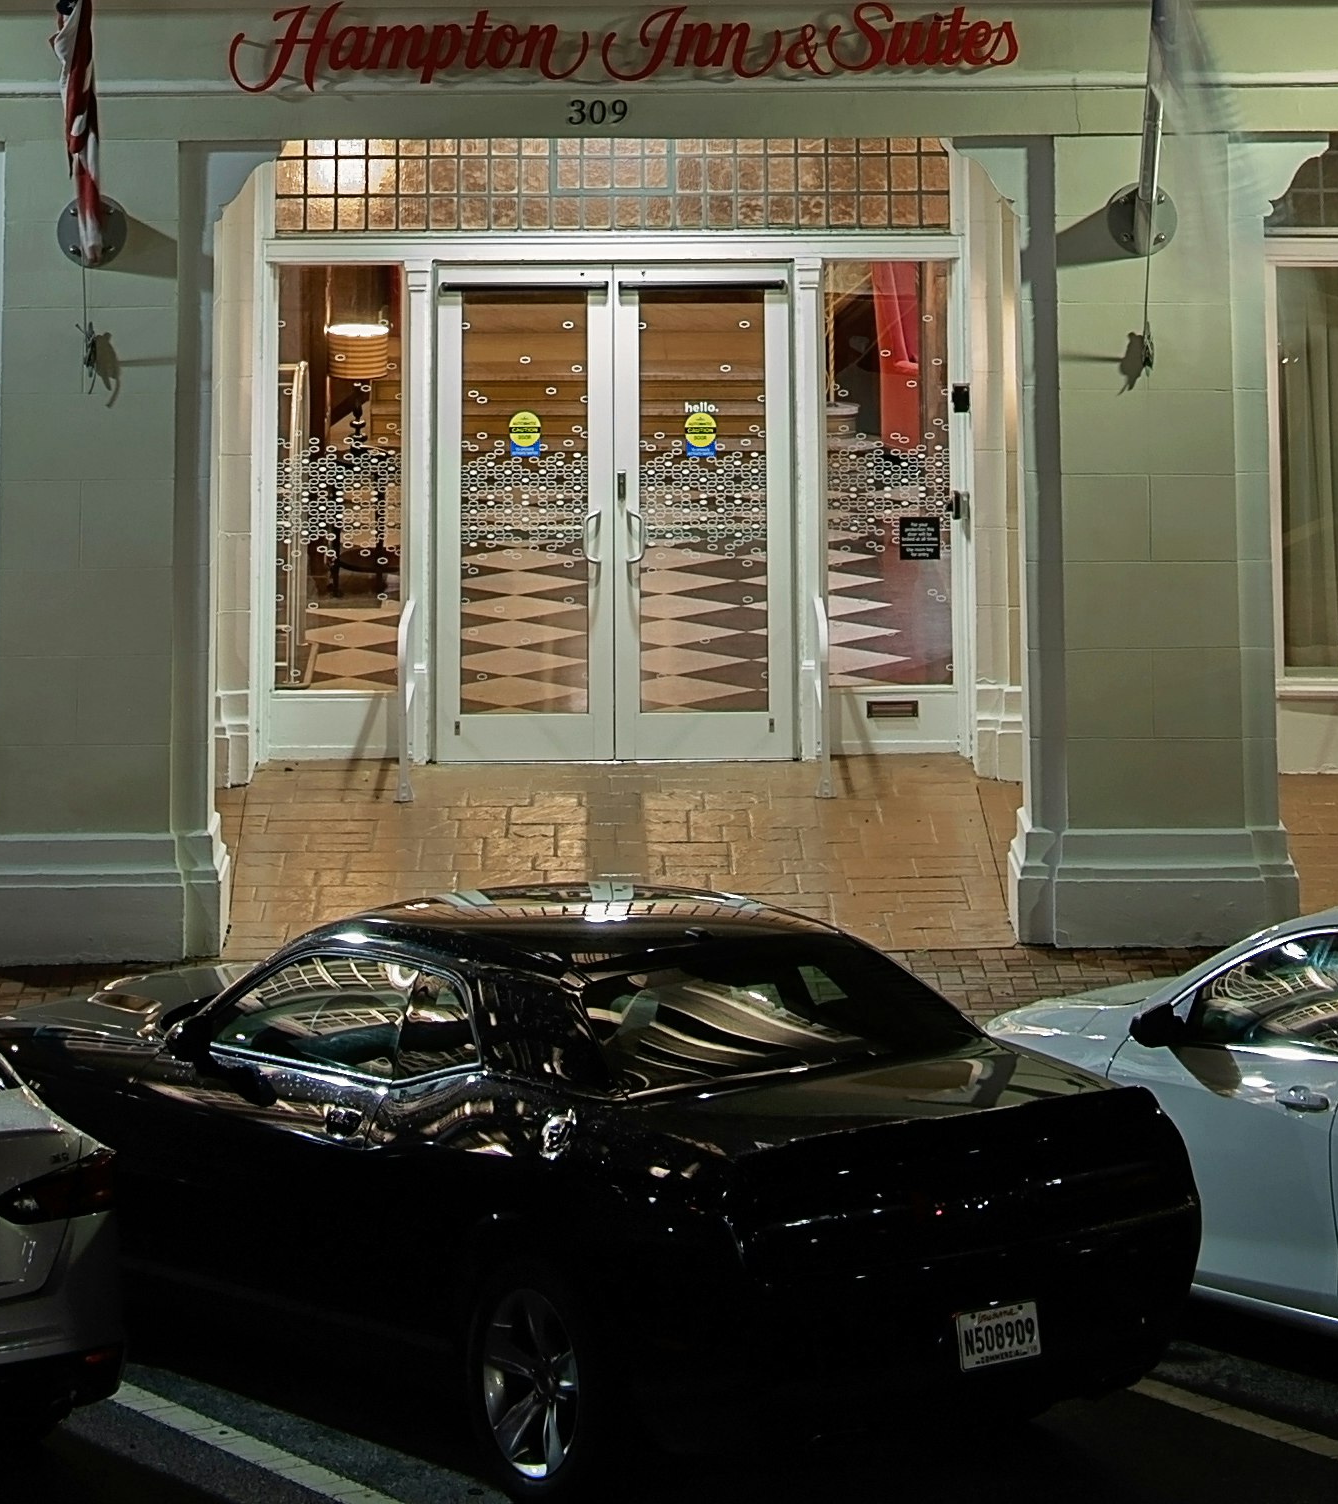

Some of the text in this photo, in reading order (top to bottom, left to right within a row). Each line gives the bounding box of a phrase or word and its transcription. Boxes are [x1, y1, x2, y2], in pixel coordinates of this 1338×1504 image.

[229, 0, 1019, 93] Hampton Inn & Suites
[568, 99, 628, 126] 309
[684, 401, 720, 413] hello.
[964, 1317, 1035, 1357] N508909
